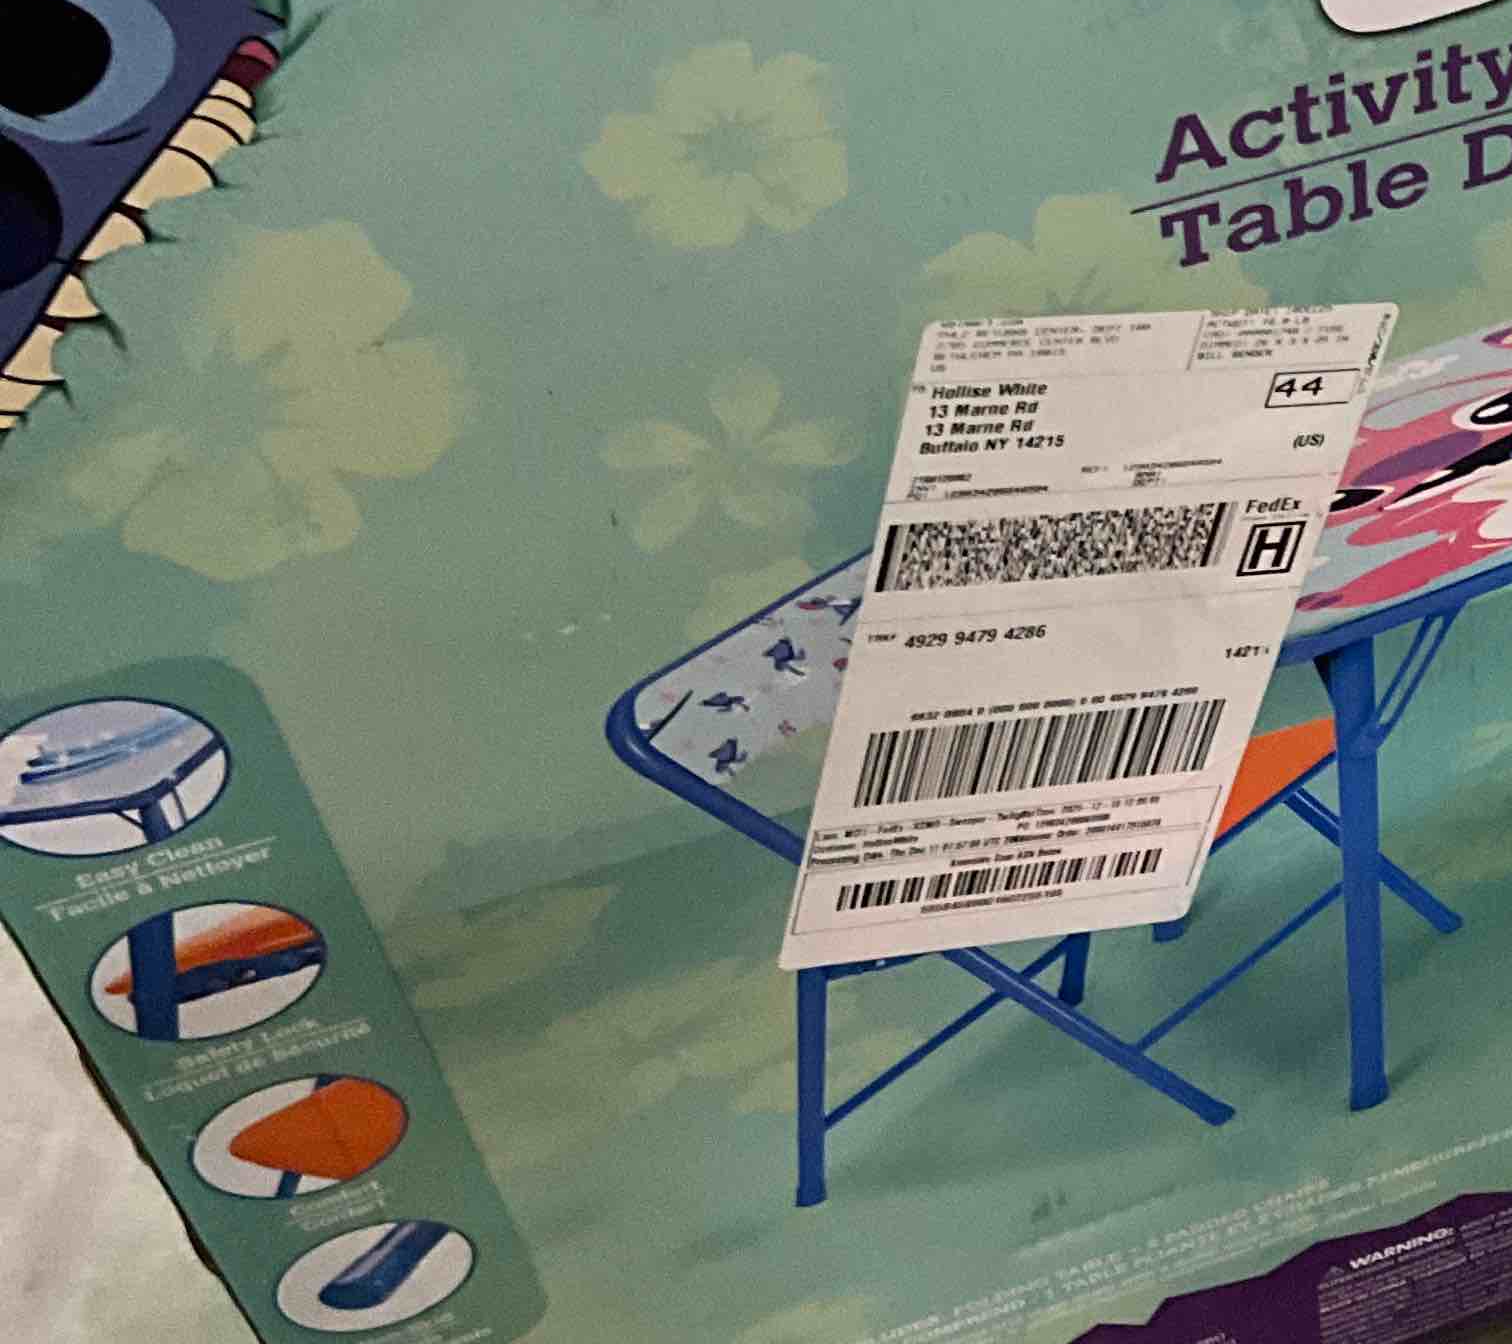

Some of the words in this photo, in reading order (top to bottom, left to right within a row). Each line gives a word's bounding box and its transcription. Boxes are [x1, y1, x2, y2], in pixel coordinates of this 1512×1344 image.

[1159, 150, 1433, 271] Table
[931, 382, 993, 400] Hollise
[998, 380, 1049, 398] White
[1273, 375, 1324, 398] 44
[928, 403, 950, 419] 13
[953, 401, 1011, 419] Marne
[1016, 400, 1039, 415] Rd
[924, 421, 946, 437] 13
[949, 419, 1006, 436] Marne
[1011, 417, 1034, 433] Rd
[919, 438, 980, 456] Buffalo
[985, 437, 1011, 453] NY
[1016, 433, 1066, 451] 14215
[1292, 433, 1326, 451] (US)
[1245, 497, 1302, 515] FedEx
[1247, 528, 1295, 570] H
[904, 631, 949, 650] 4929
[954, 627, 998, 646] 9479
[75, 861, 140, 889] Easy
[147, 836, 224, 867] Clean
[48, 888, 130, 922] Facile
[159, 846, 272, 889] Nettoyer
[1349, 1226, 1456, 1270] WARNING:
